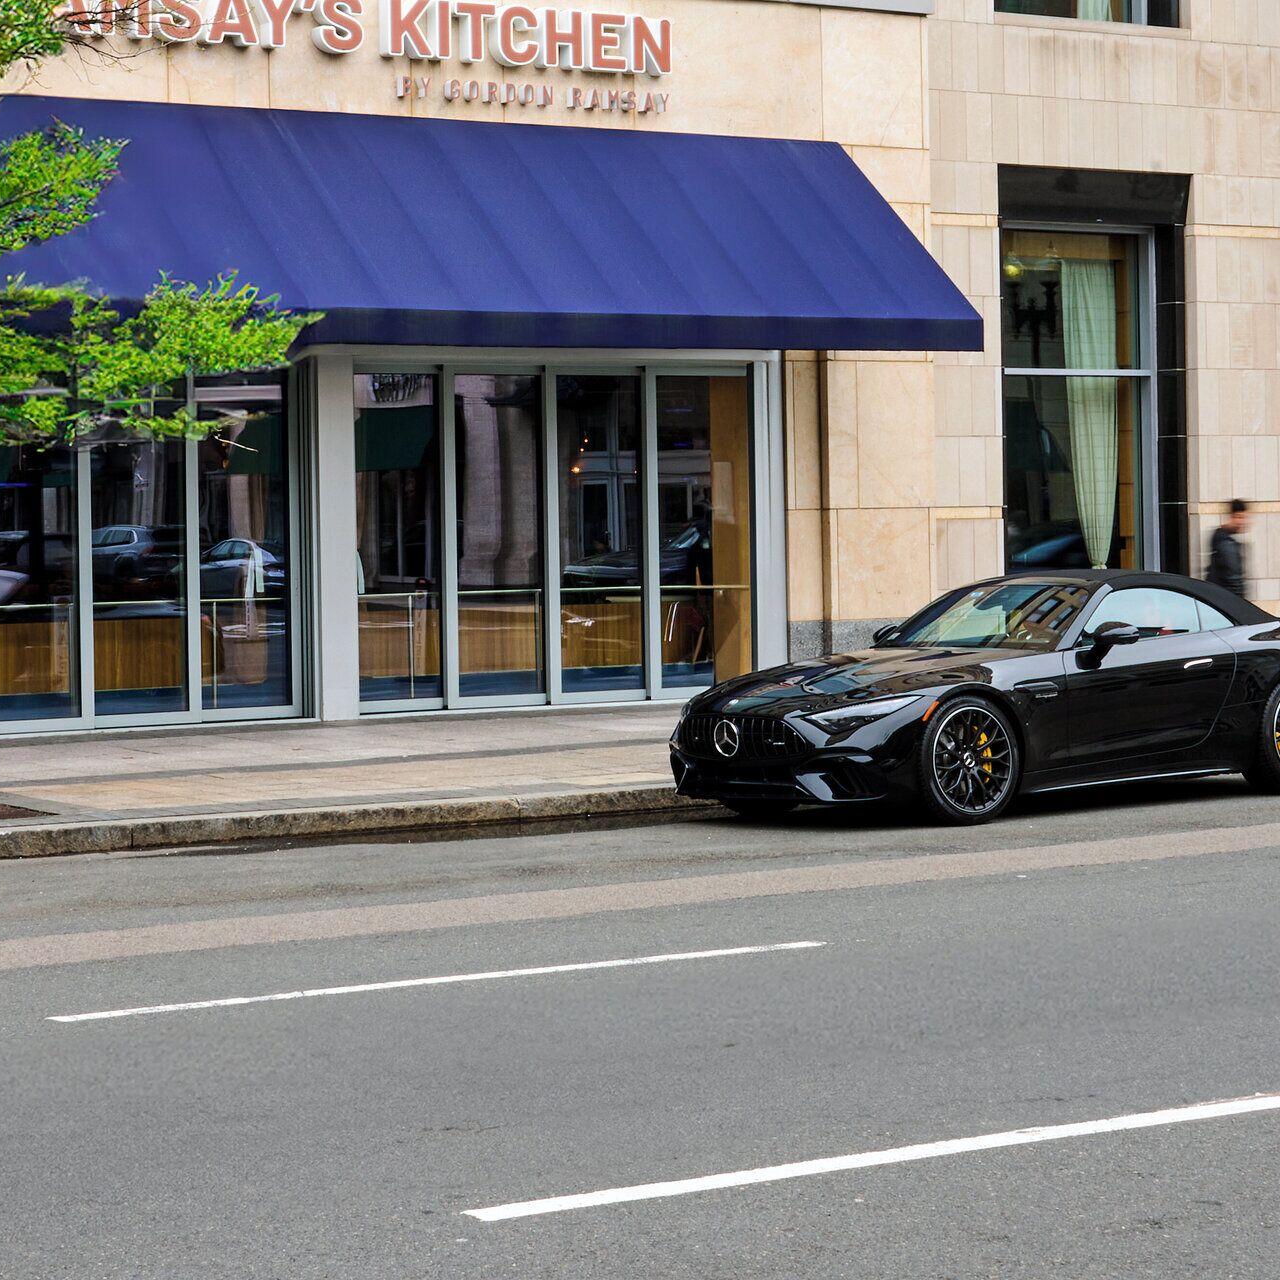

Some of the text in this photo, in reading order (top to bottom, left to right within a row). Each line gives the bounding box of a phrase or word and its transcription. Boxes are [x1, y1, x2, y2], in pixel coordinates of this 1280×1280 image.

[396, 75, 670, 116] BY GORDON RAMSAY
